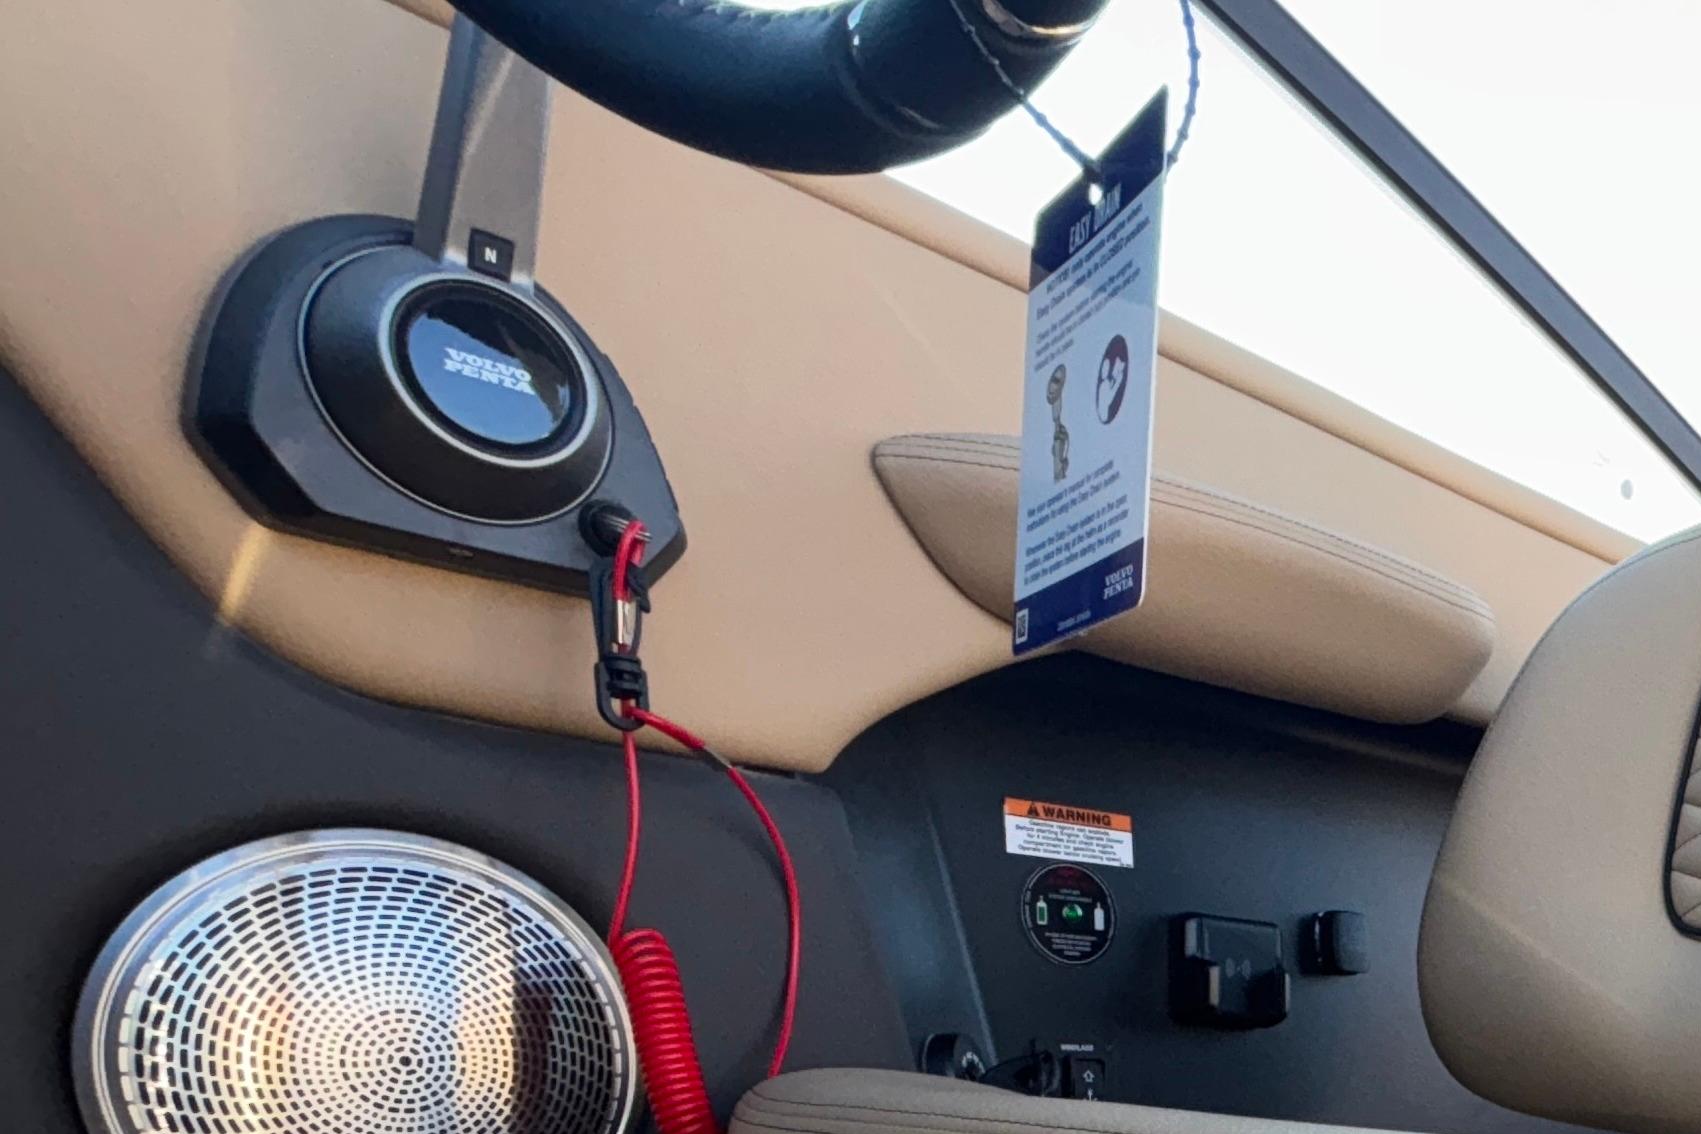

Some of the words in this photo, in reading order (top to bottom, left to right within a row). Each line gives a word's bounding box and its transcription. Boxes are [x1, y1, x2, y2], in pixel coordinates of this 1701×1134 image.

[1069, 211, 1091, 254] EASY
[485, 246, 497, 263] N
[444, 347, 532, 382] VOLVO
[443, 359, 537, 395] PENTA
[1105, 564, 1133, 586] VOLVO
[1104, 576, 1134, 600] PENTA
[1043, 805, 1112, 826] WARNING
